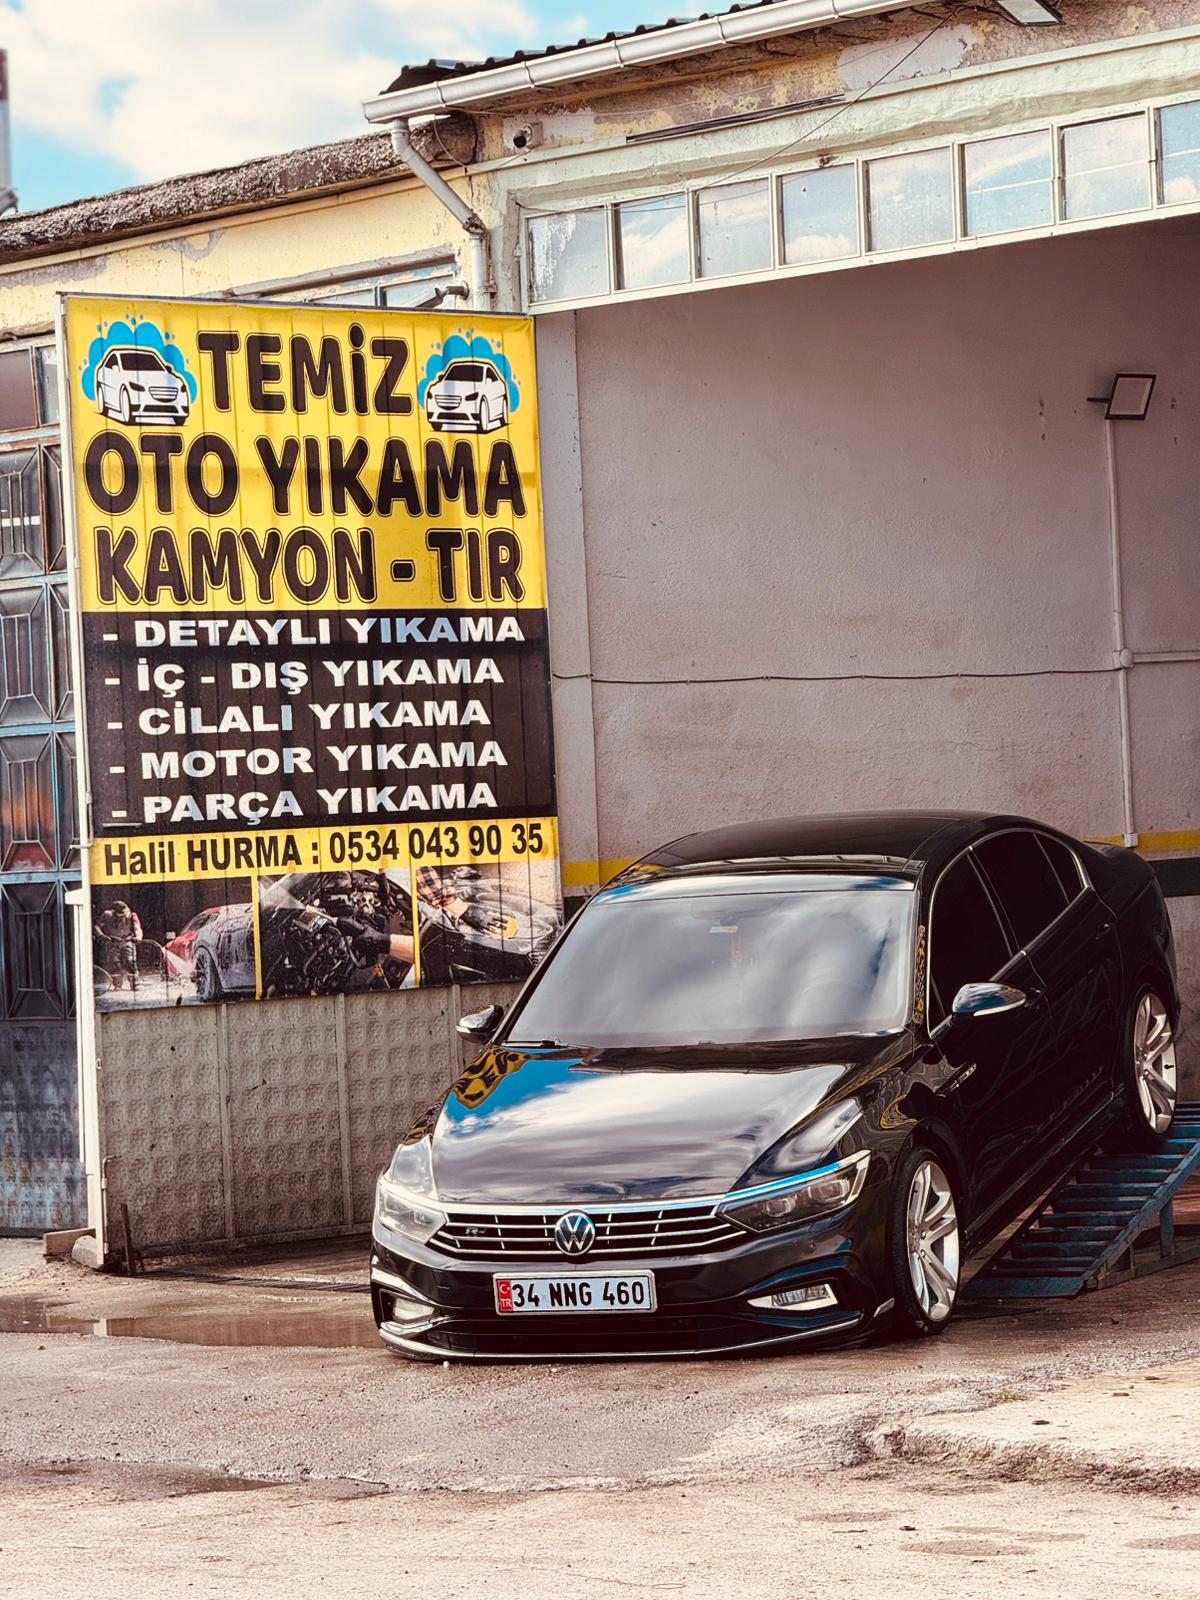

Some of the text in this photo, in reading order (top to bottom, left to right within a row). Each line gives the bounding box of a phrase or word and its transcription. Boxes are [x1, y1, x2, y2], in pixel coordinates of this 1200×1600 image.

[82, 428, 527, 518] OTO YIKAMA
[95, 525, 376, 605] KAMYON
[425, 528, 525, 604] TIR
[134, 618, 330, 648] DETAYLI
[346, 617, 525, 643] YIKAMA
[136, 658, 185, 698] İÇ
[231, 661, 309, 695] DIŞ
[322, 658, 504, 687] YIKAMA
[138, 701, 293, 736] CİLALI
[309, 700, 491, 731] YIKAMA
[141, 748, 314, 780] MOTOR
[326, 741, 508, 772] YIKAMA
[143, 791, 303, 826] PARÇA
[316, 783, 498, 815] YIKAMA
[104, 840, 175, 876] Halil
[187, 833, 302, 872] HURMA
[329, 829, 399, 864] 0534
[410, 825, 460, 860] 043
[470, 824, 502, 857] 90
[512, 823, 543, 855] 35
[556, 1211, 594, 1254] VW
[500, 1298, 512, 1308] TR
[512, 1281, 644, 1307] 34 NNG 460
